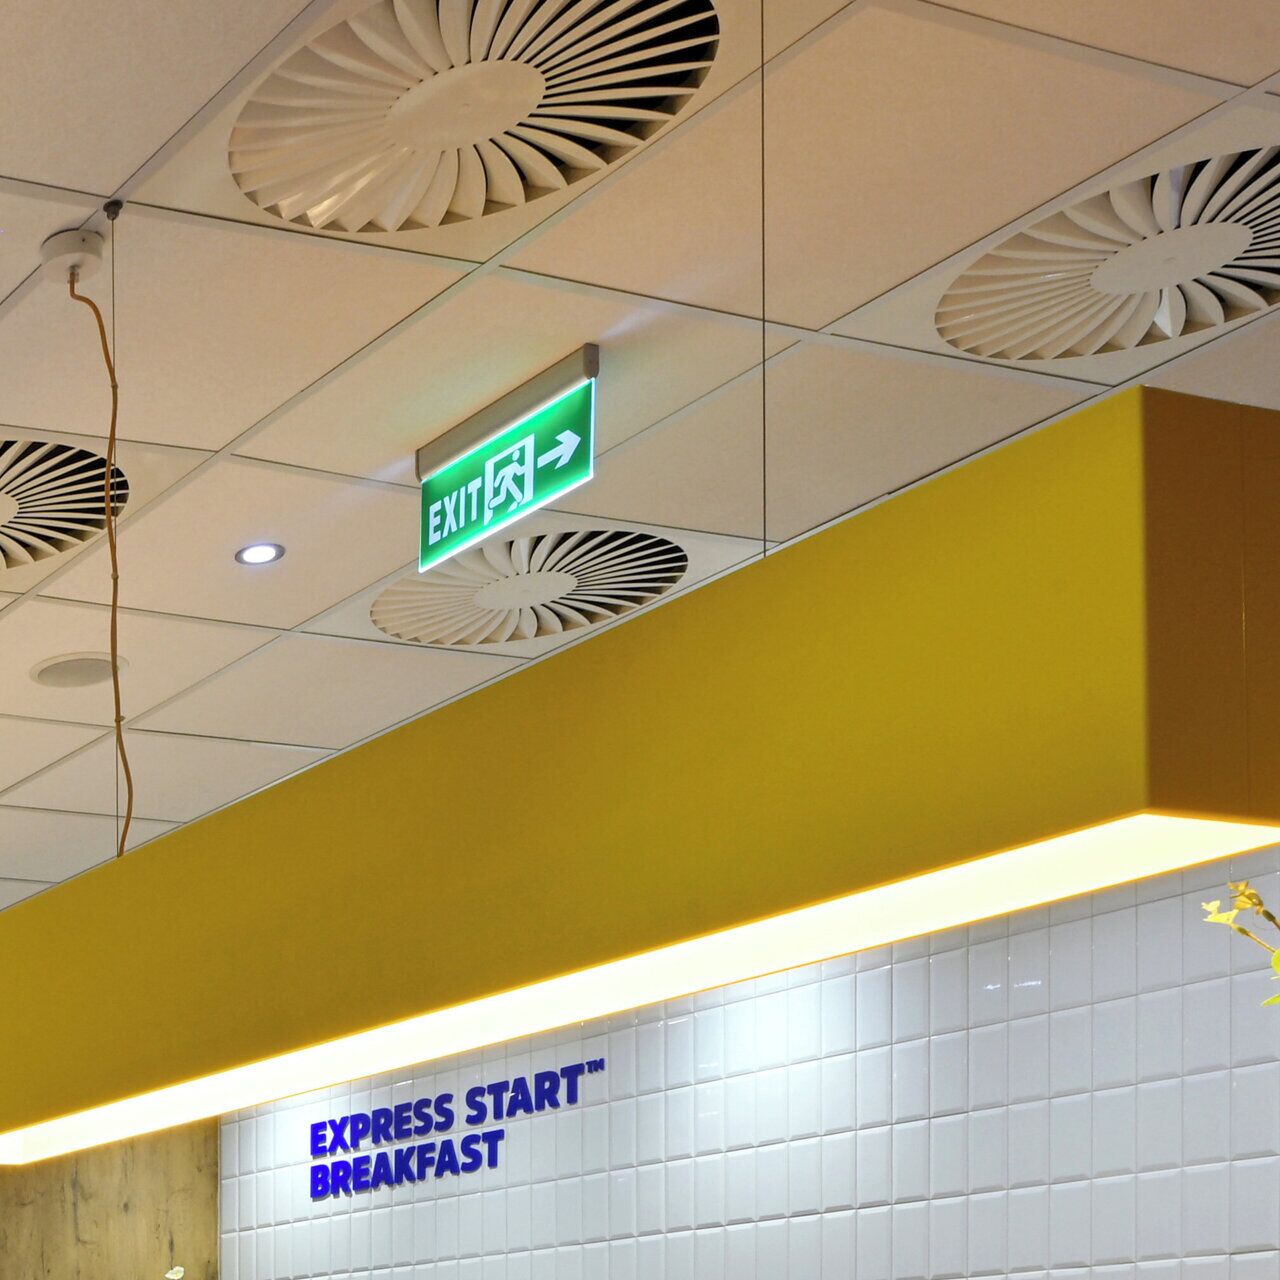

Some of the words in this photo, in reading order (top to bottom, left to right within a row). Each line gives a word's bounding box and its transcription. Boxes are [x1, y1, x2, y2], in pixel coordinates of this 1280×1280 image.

[429, 476, 482, 545] EXIT
[310, 1093, 454, 1157] EXPRESS
[310, 1129, 505, 1199] BREAKFAST
